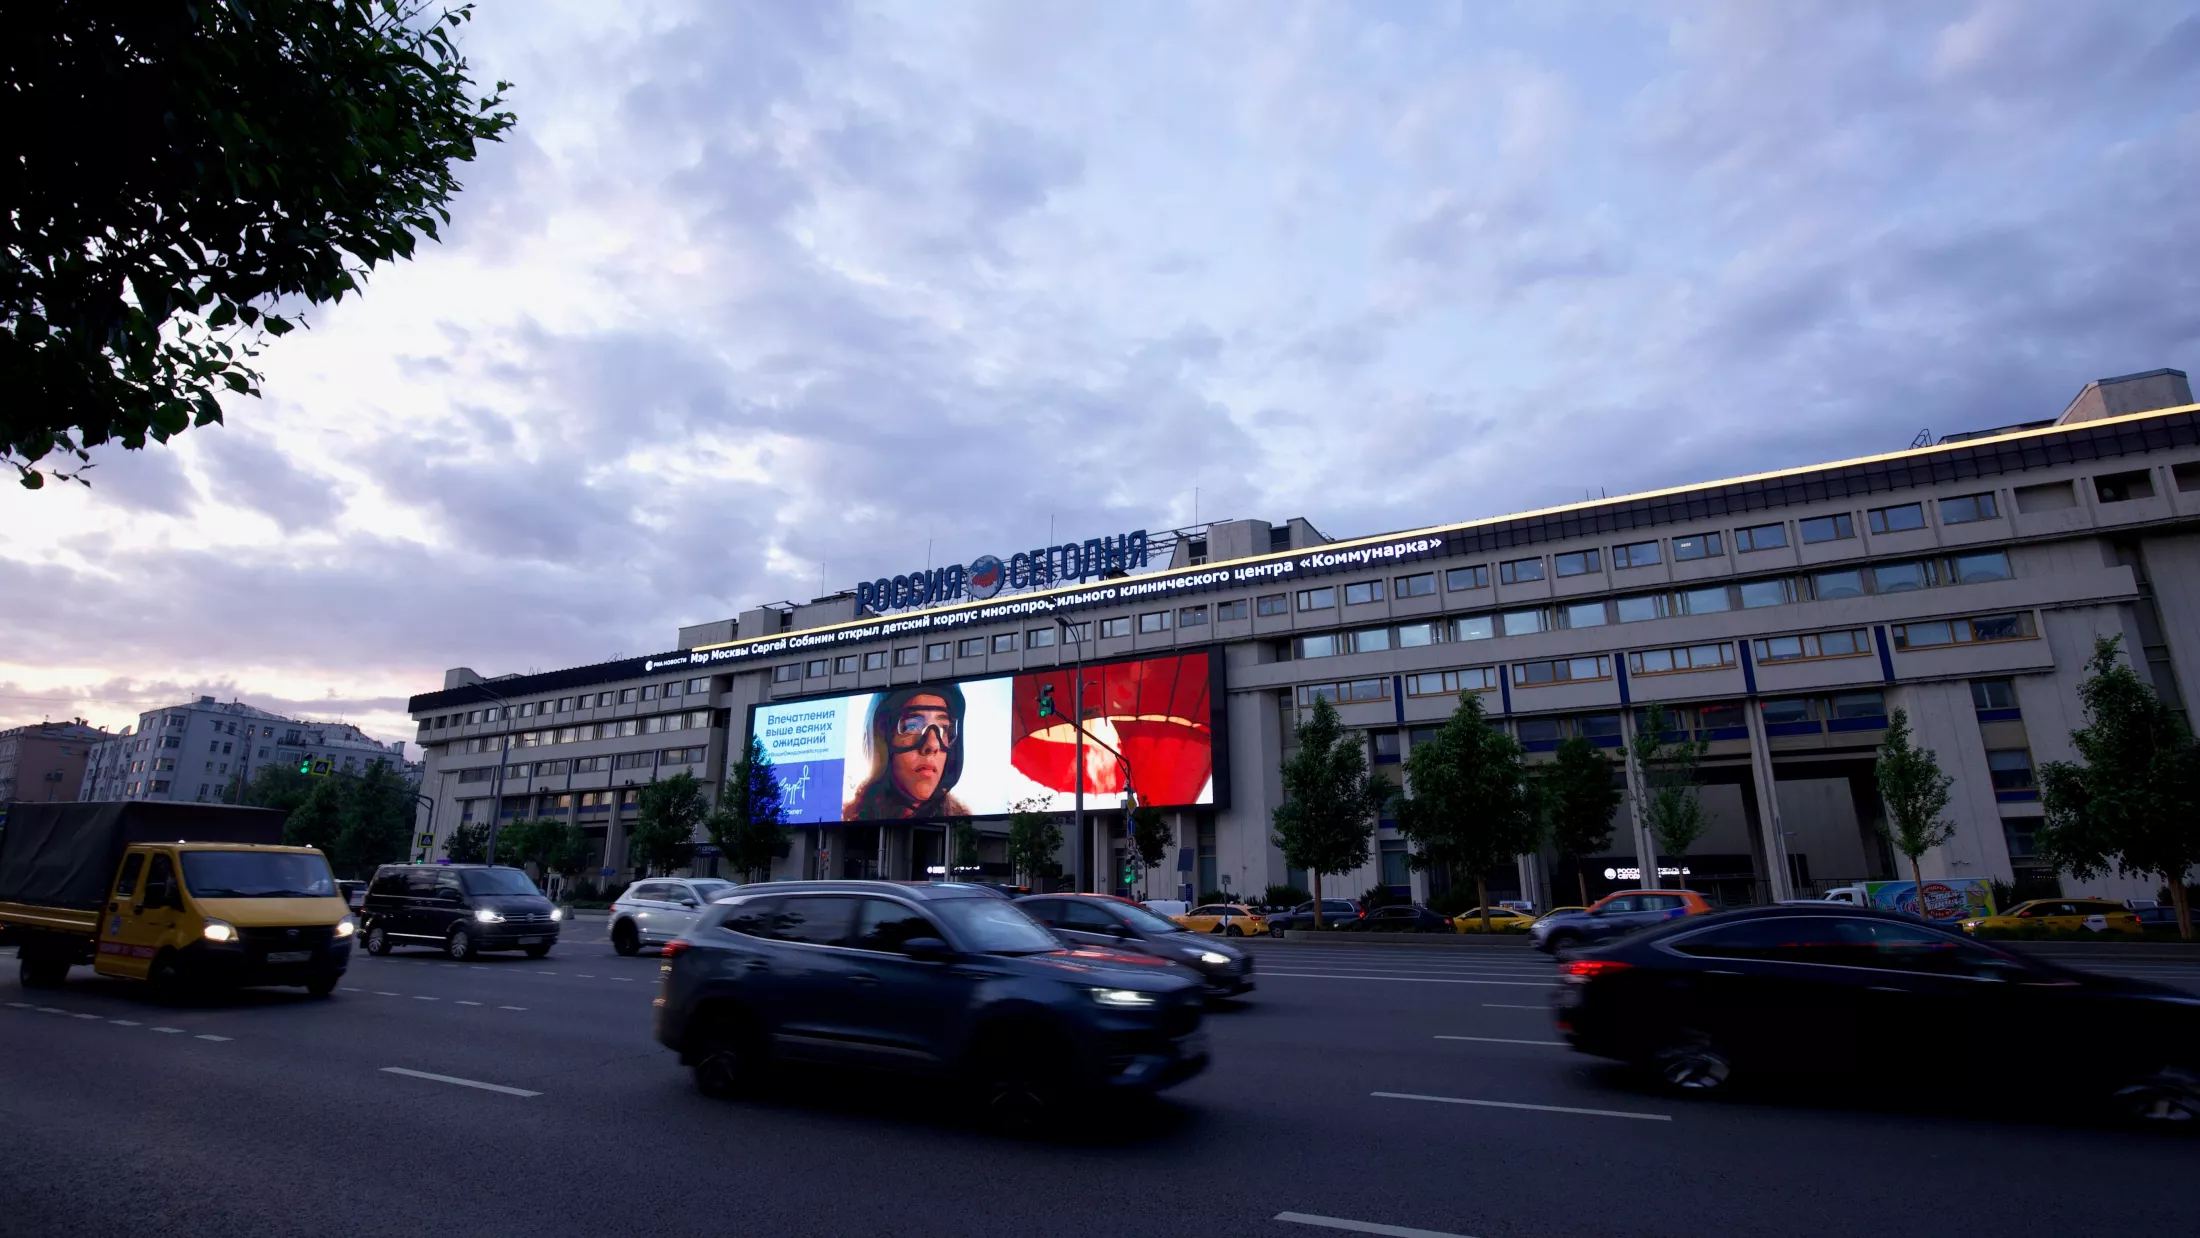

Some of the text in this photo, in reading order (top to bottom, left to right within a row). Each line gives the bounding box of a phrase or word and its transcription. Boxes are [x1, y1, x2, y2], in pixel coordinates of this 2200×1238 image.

[856, 530, 1147, 615] РОССИЯ СЕГОДНЯ
[691, 653, 709, 663] Мэр
[711, 647, 749, 660] Москвы
[751, 638, 787, 654] Сергей
[789, 633, 835, 648] Собянин
[838, 626, 879, 640] открыл
[882, 615, 930, 635] детский
[934, 610, 978, 625] корпус
[1120, 571, 1230, 597] клинического
[1235, 561, 1294, 580] центра
[1300, 538, 1442, 567] «Коммунарка»
[664, 657, 687, 666] НОВОСТИ
[768, 710, 835, 725] Впечатления
[766, 722, 832, 736] выше всяких
[773, 732, 825, 747] ожиданий
